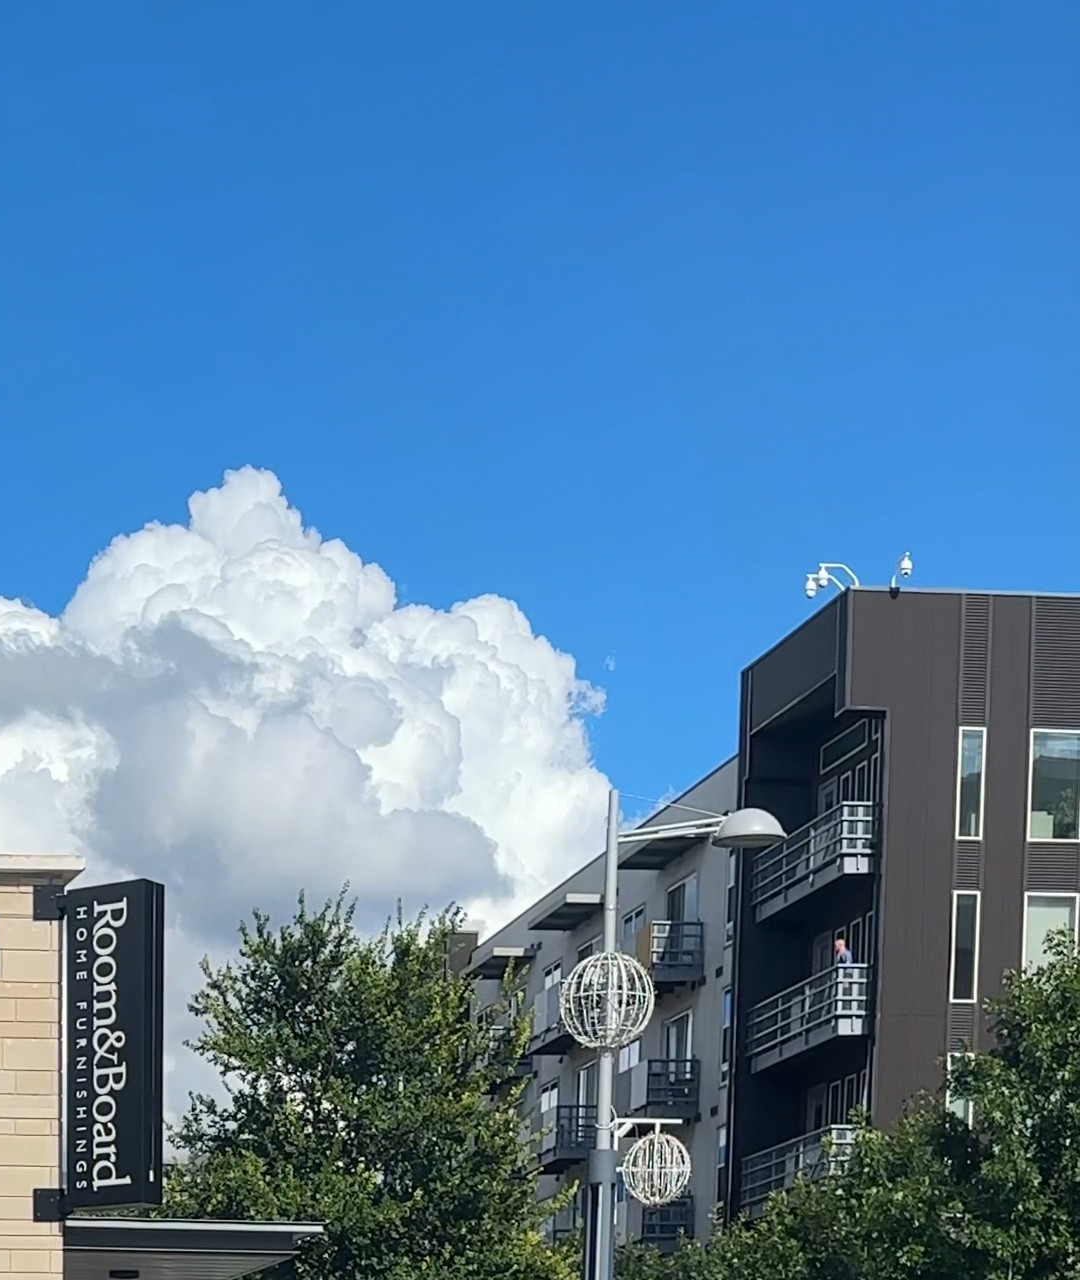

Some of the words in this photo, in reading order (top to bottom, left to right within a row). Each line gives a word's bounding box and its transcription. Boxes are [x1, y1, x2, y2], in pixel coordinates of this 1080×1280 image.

[76, 906, 88, 980] HOME
[76, 1001, 88, 1189] FURNISHINGS
[92, 896, 132, 1192] Room&Board
